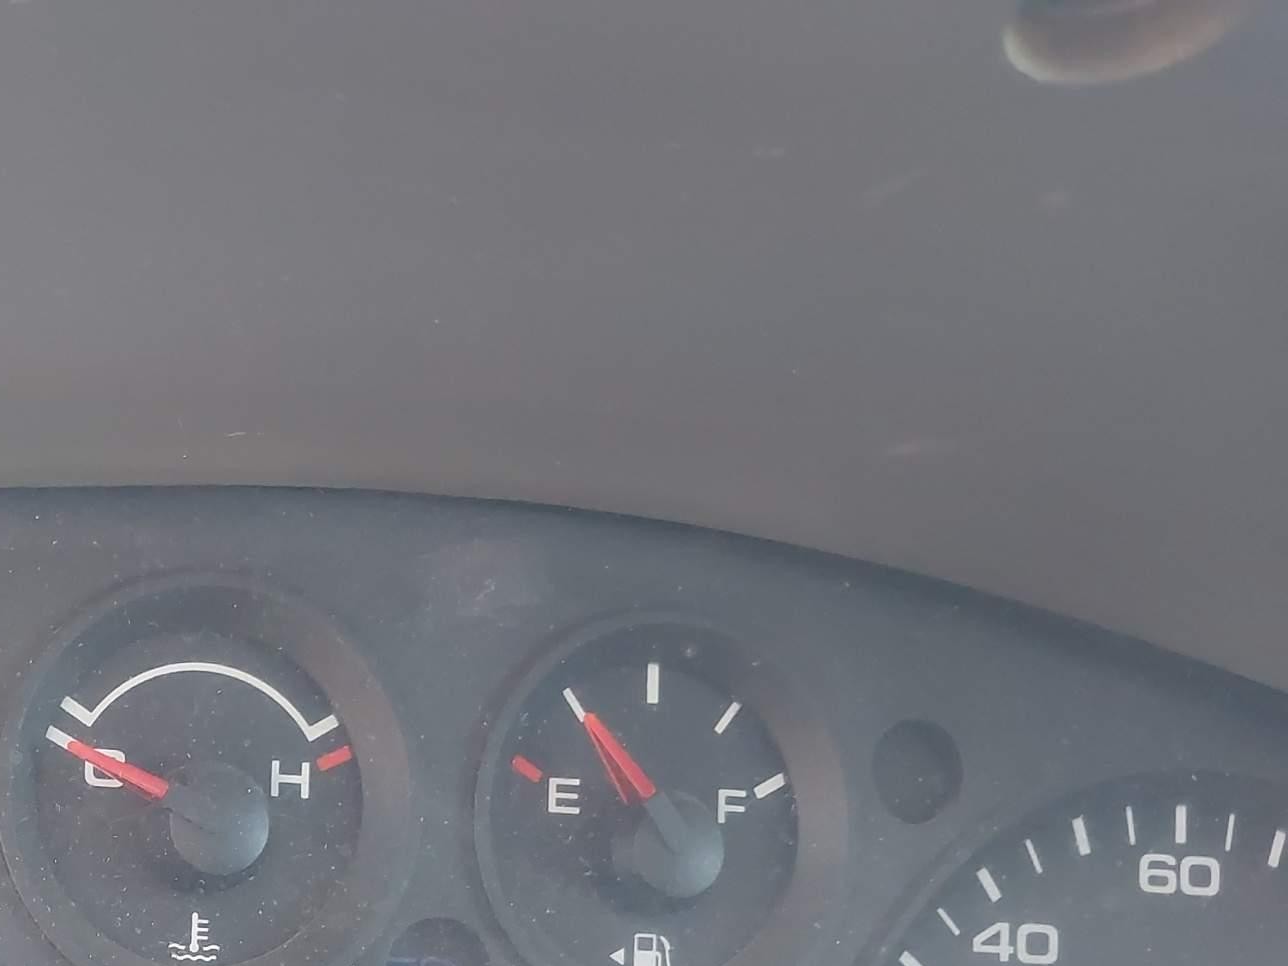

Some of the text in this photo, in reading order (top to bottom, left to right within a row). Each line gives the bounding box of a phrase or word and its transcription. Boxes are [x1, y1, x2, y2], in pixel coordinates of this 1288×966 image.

[84, 747, 126, 788] C
[270, 759, 311, 800] H
[548, 777, 581, 815] E
[717, 788, 747, 824] F
[1138, 853, 1220, 897] 60
[972, 922, 1059, 965] 40
